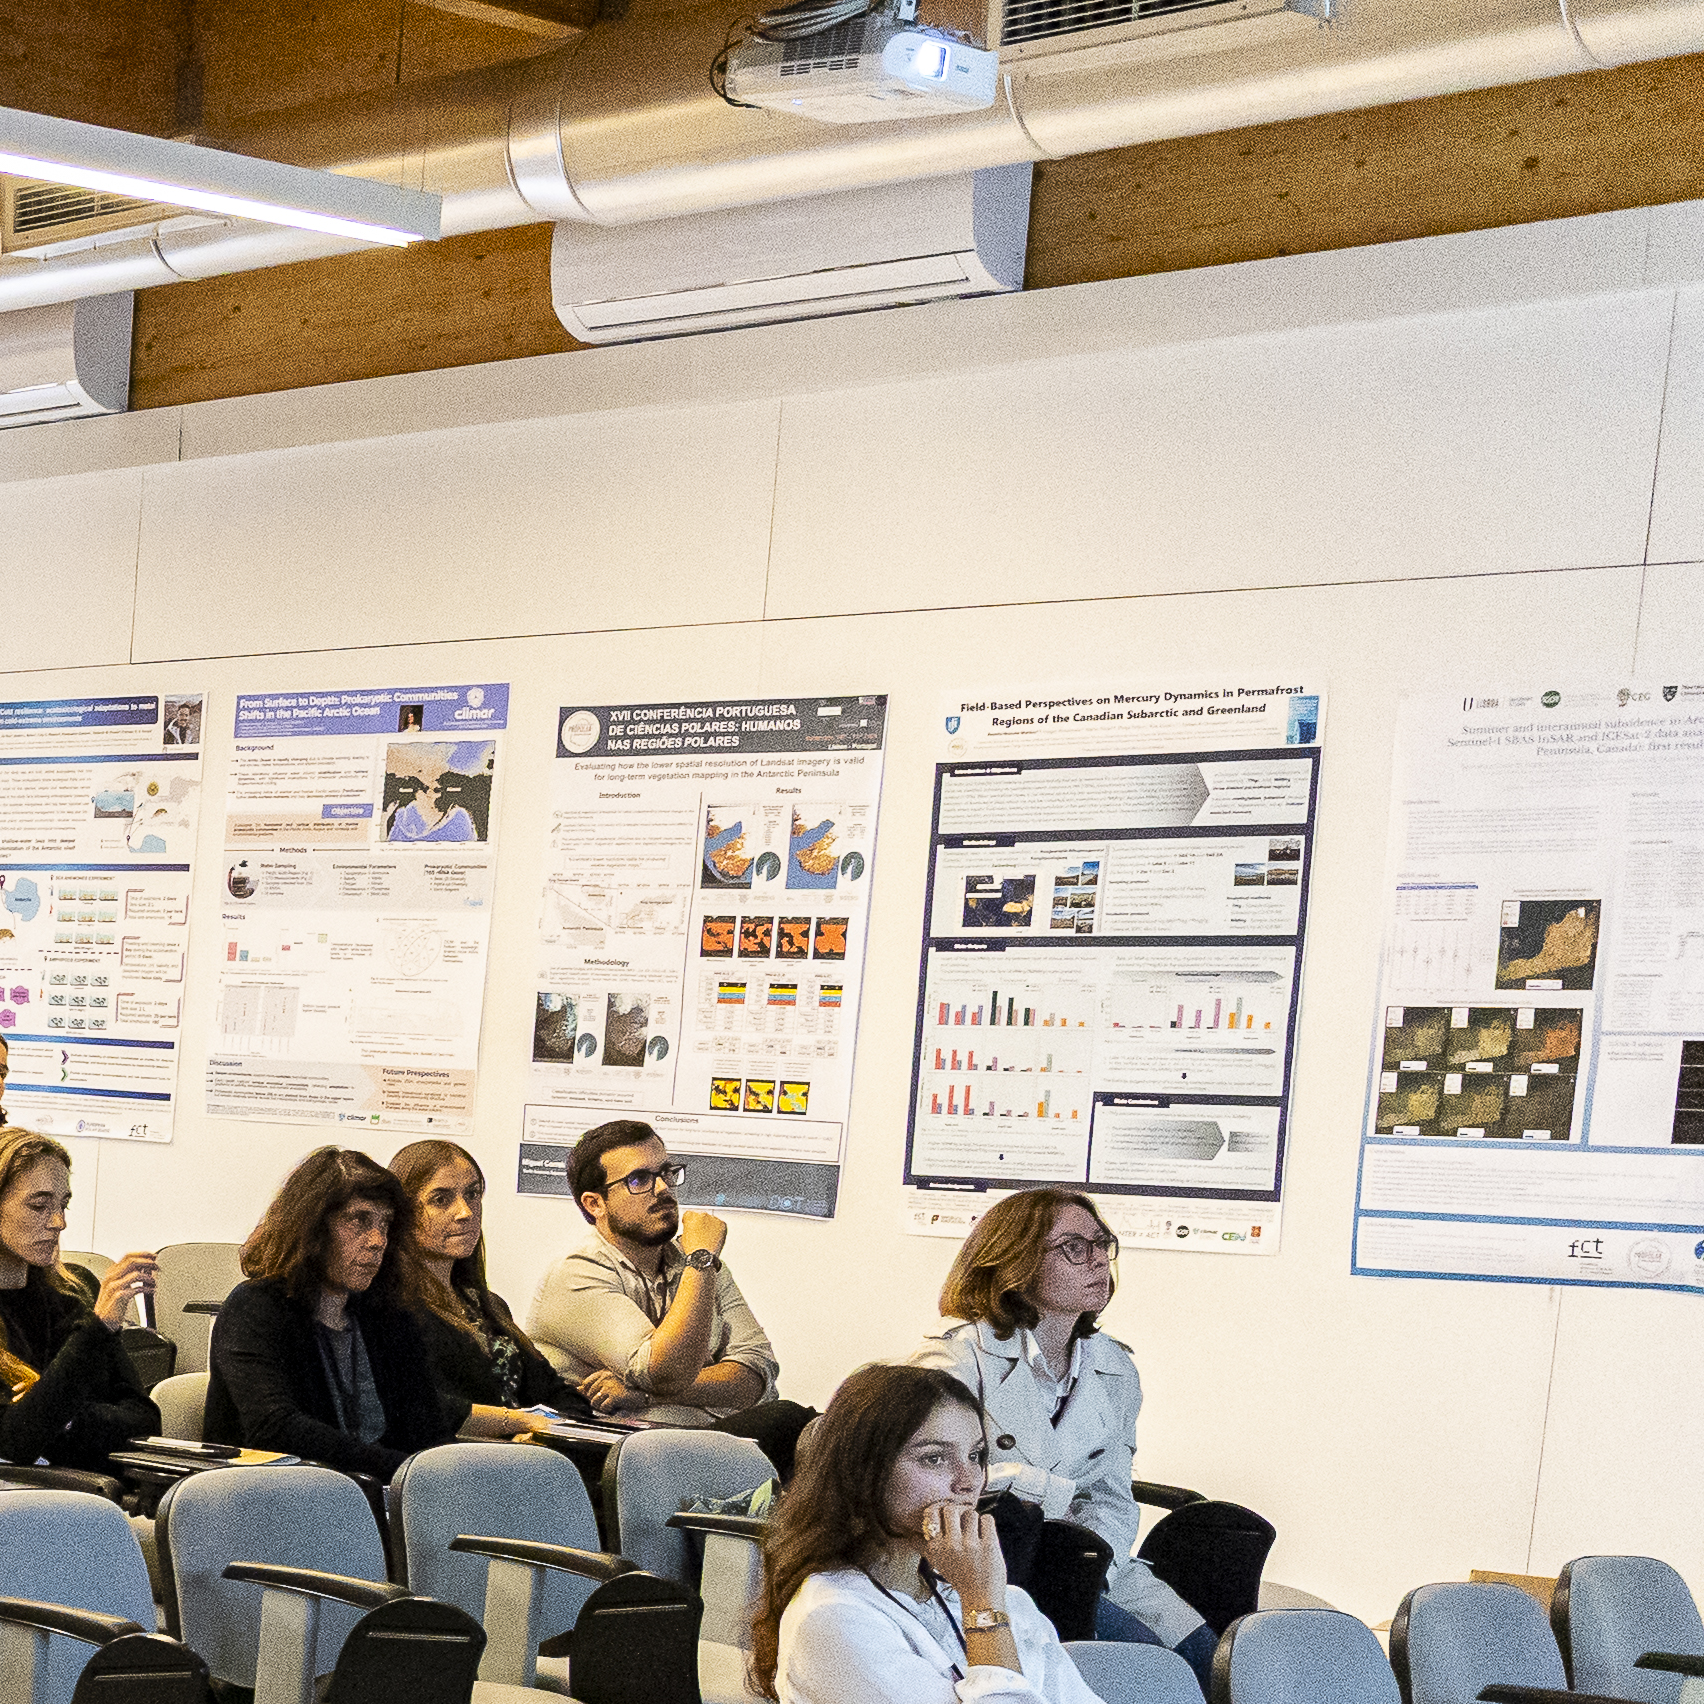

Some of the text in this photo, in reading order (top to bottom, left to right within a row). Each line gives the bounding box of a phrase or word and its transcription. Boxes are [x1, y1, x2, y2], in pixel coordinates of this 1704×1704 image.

[239, 691, 458, 709] From Surface to Depth: Prokaryotic Communities
[960, 700, 1021, 713] Field-Based
[1025, 697, 1093, 711] Perspectives
[1114, 693, 1161, 706] Mercury
[1164, 690, 1219, 704] Dynamics
[1222, 690, 1234, 699] in
[1237, 686, 1304, 698] Permafrost
[239, 706, 380, 720] Shifts in the Pacific Arctic Ocean
[610, 705, 796, 721] XVII CONFERÊNCIA PORTUGUESA
[992, 704, 1266, 729] Regions of the Canadian Subarctic and Greenland
[609, 720, 801, 736] DE CIÊNCIAS POLARES: HUMANOS
[1461, 723, 1510, 735] Summer
[1513, 723, 1533, 733] and
[1669, 717, 1681, 726] in
[607, 735, 739, 750] NAS REGIÕES POLARES
[1504, 734, 1534, 745] SBAS
[1537, 733, 1575, 743] InSAR
[1579, 732, 1598, 742] and
[1654, 730, 1678, 739] data
[236, 744, 275, 752] Background
[575, 757, 865, 772] Evaluating how the lower spatial resolution of Landsat imagery is valid
[594, 773, 606, 781] for
[607, 773, 645, 782] long-term
[647, 772, 690, 781] vegetation
[692, 771, 729, 781] mapping
[756, 770, 795, 778] Antarctic
[798, 769, 840, 777] Peninsula
[584, 959, 629, 967] Methodology
[383, 1068, 403, 1076] Future
[655, 1116, 699, 1124] Conclusions
[129, 1124, 149, 1137] fct
[1567, 1238, 1603, 1258] fct
